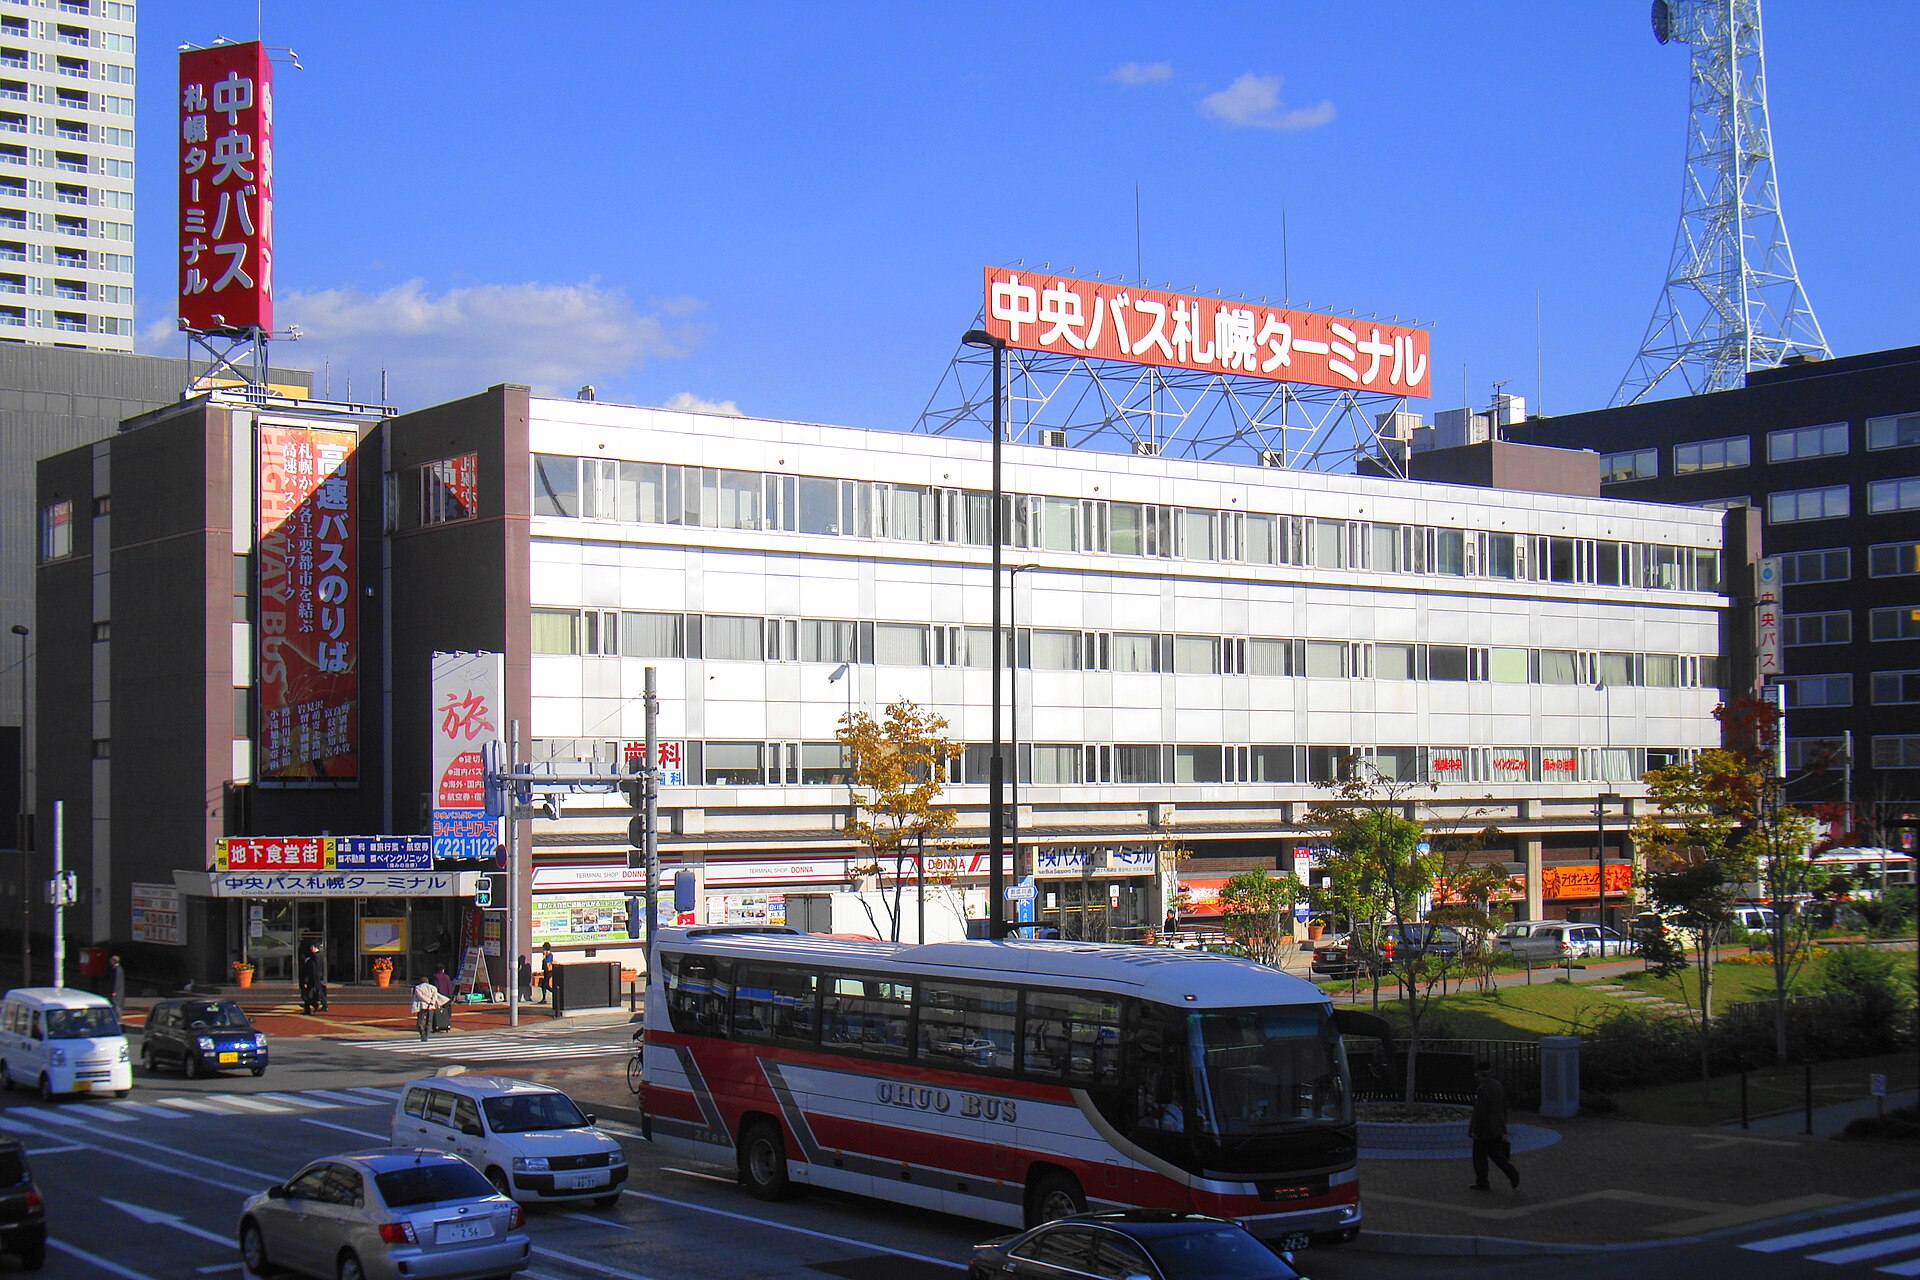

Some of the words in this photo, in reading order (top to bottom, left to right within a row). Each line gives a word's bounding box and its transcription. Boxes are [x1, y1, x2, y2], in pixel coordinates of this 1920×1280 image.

[183, 83, 207, 296] 札幌ターミナル
[212, 71, 256, 293] 中央バス
[991, 274, 1427, 387] 中央バス札幌ターミナル
[282, 442, 296, 600] 高速バスネットワーク
[298, 443, 314, 633] 札幌から各主要都市を結ぶ
[316, 443, 349, 673] 高速バスのりば
[262, 611, 287, 684] BUS
[1761, 591, 1776, 668] 中央バス
[437, 688, 495, 741] 旅
[464, 755, 483, 764] 貸切
[447, 793, 484, 801] 航空券・宿
[448, 781, 484, 789] 海外・国内
[231, 844, 318, 864] 地下食堂街
[377, 854, 429, 863] ペインクリニック
[444, 838, 497, 856] 221-1122
[928, 858, 965, 870] DONNA
[225, 876, 446, 890] 中央バス札幌ターミナル
[576, 872, 602, 880] TERMINAL
[622, 871, 647, 879] DONNA
[875, 1081, 950, 1113] CHUO
[960, 1093, 1017, 1123] BUS
